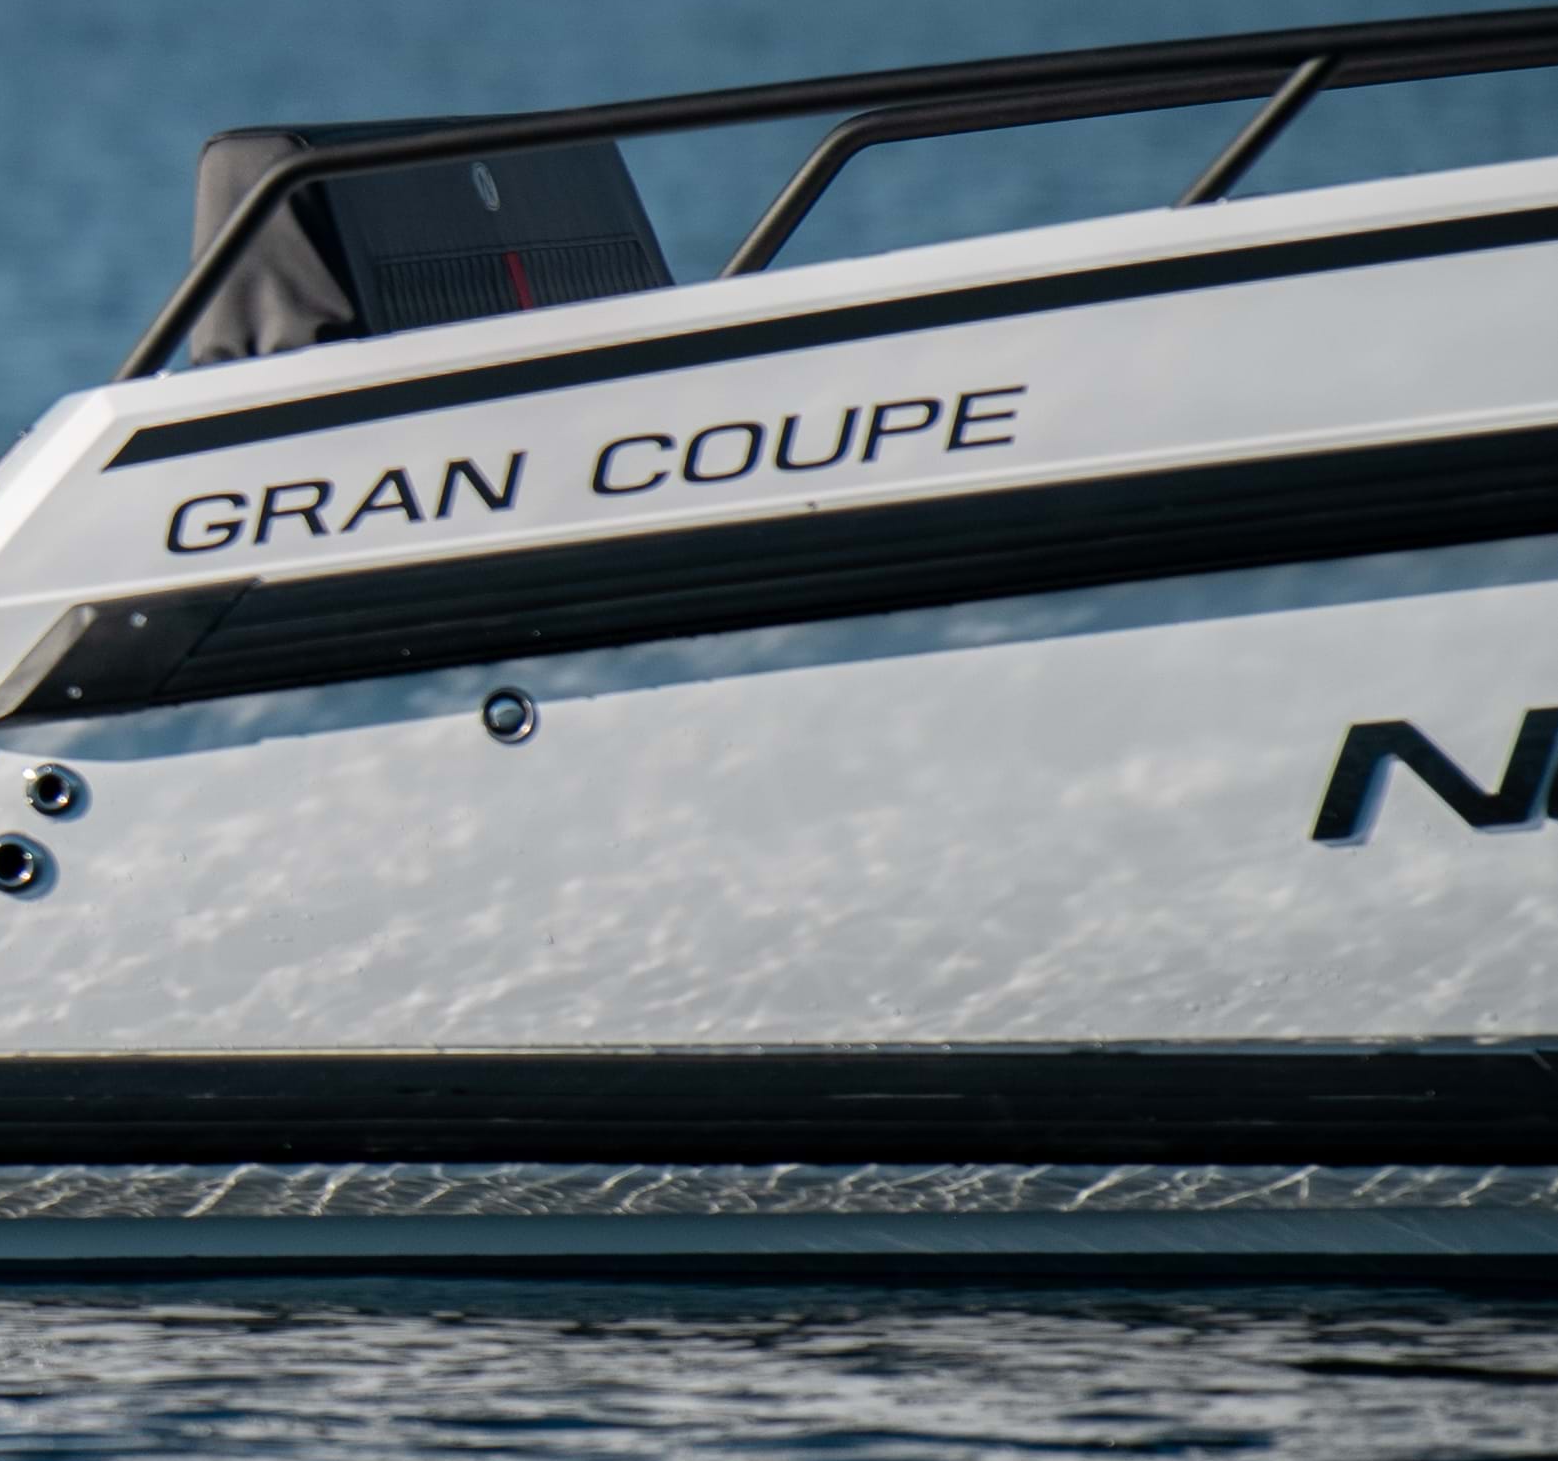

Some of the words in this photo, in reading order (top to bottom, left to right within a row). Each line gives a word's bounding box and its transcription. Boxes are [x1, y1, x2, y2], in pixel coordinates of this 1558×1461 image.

[166, 451, 526, 555] GRAN
[591, 385, 1027, 496] COUPE
[1310, 705, 1558, 843] N
